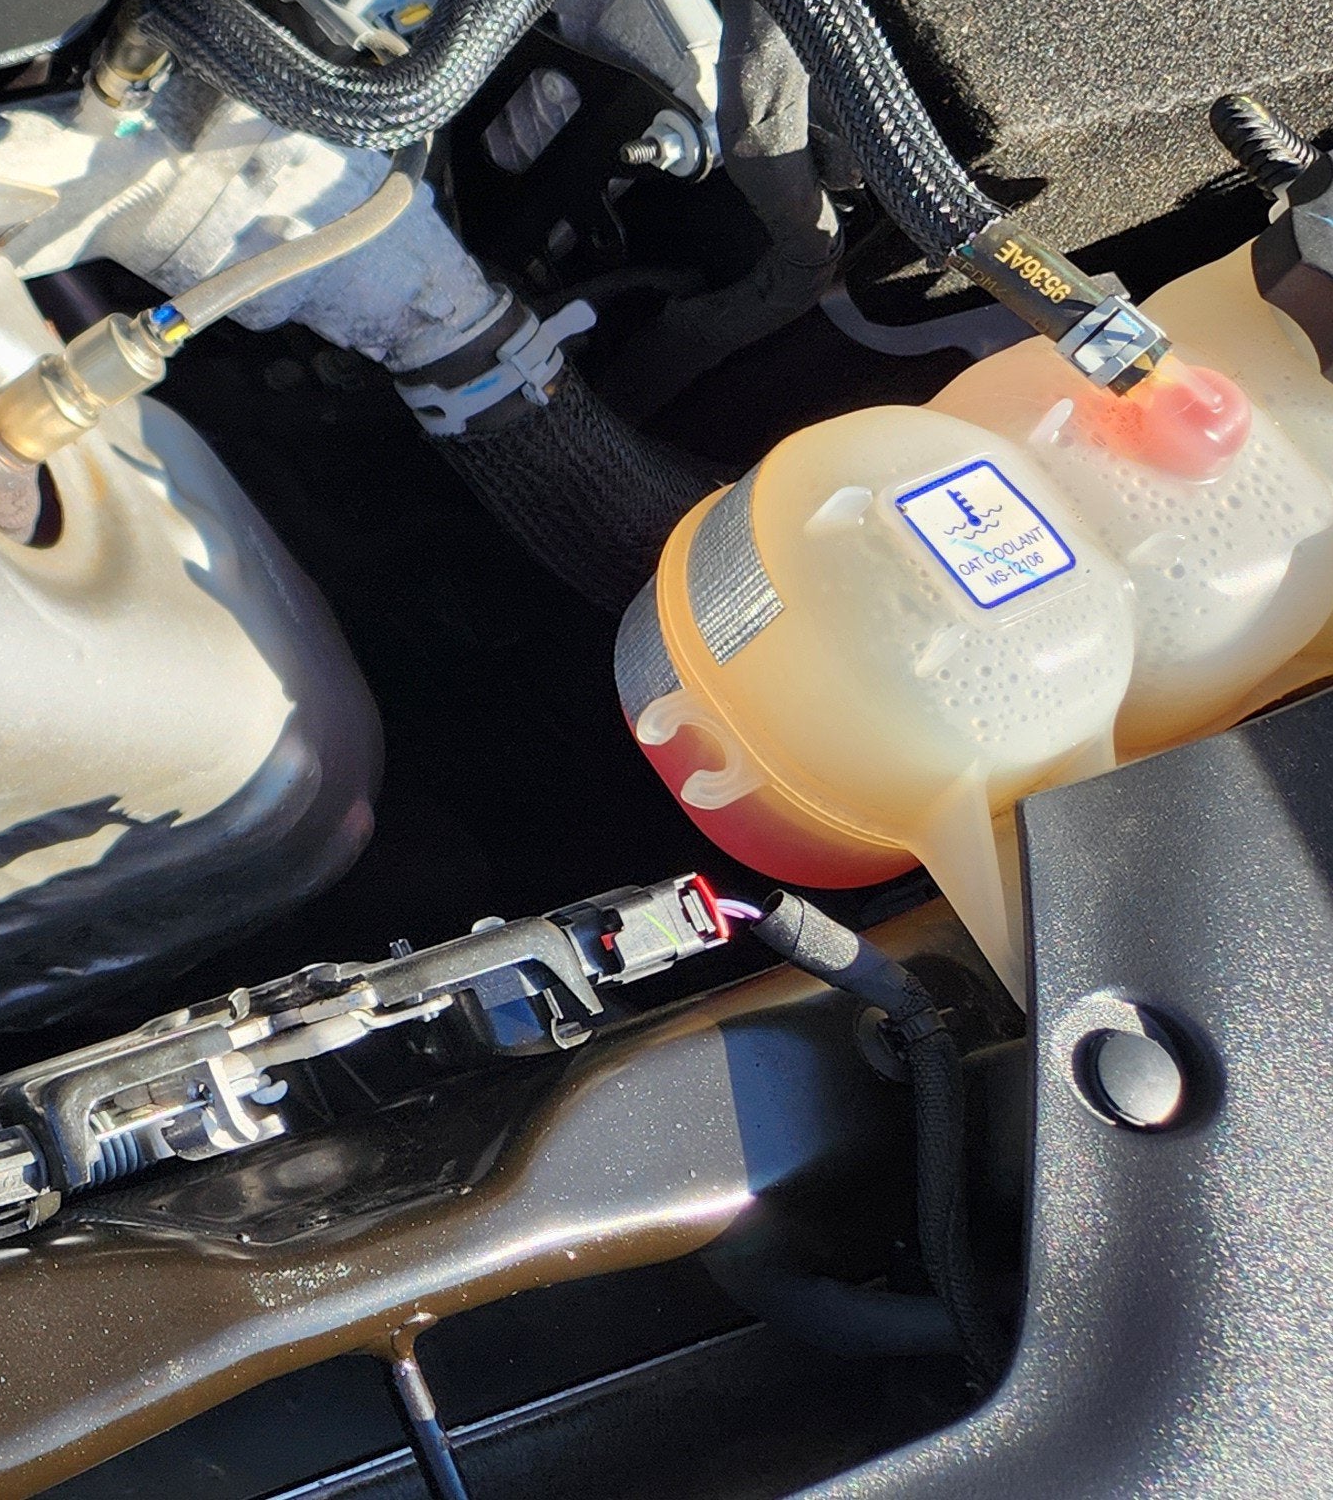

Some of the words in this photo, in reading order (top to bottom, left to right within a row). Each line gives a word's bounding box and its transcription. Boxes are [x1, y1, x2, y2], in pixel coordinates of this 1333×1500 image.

[993, 239, 1073, 305] 9536AE
[958, 556, 986, 577] OAT
[983, 526, 1046, 565] COOLANT
[985, 551, 1045, 588] MS-12106
